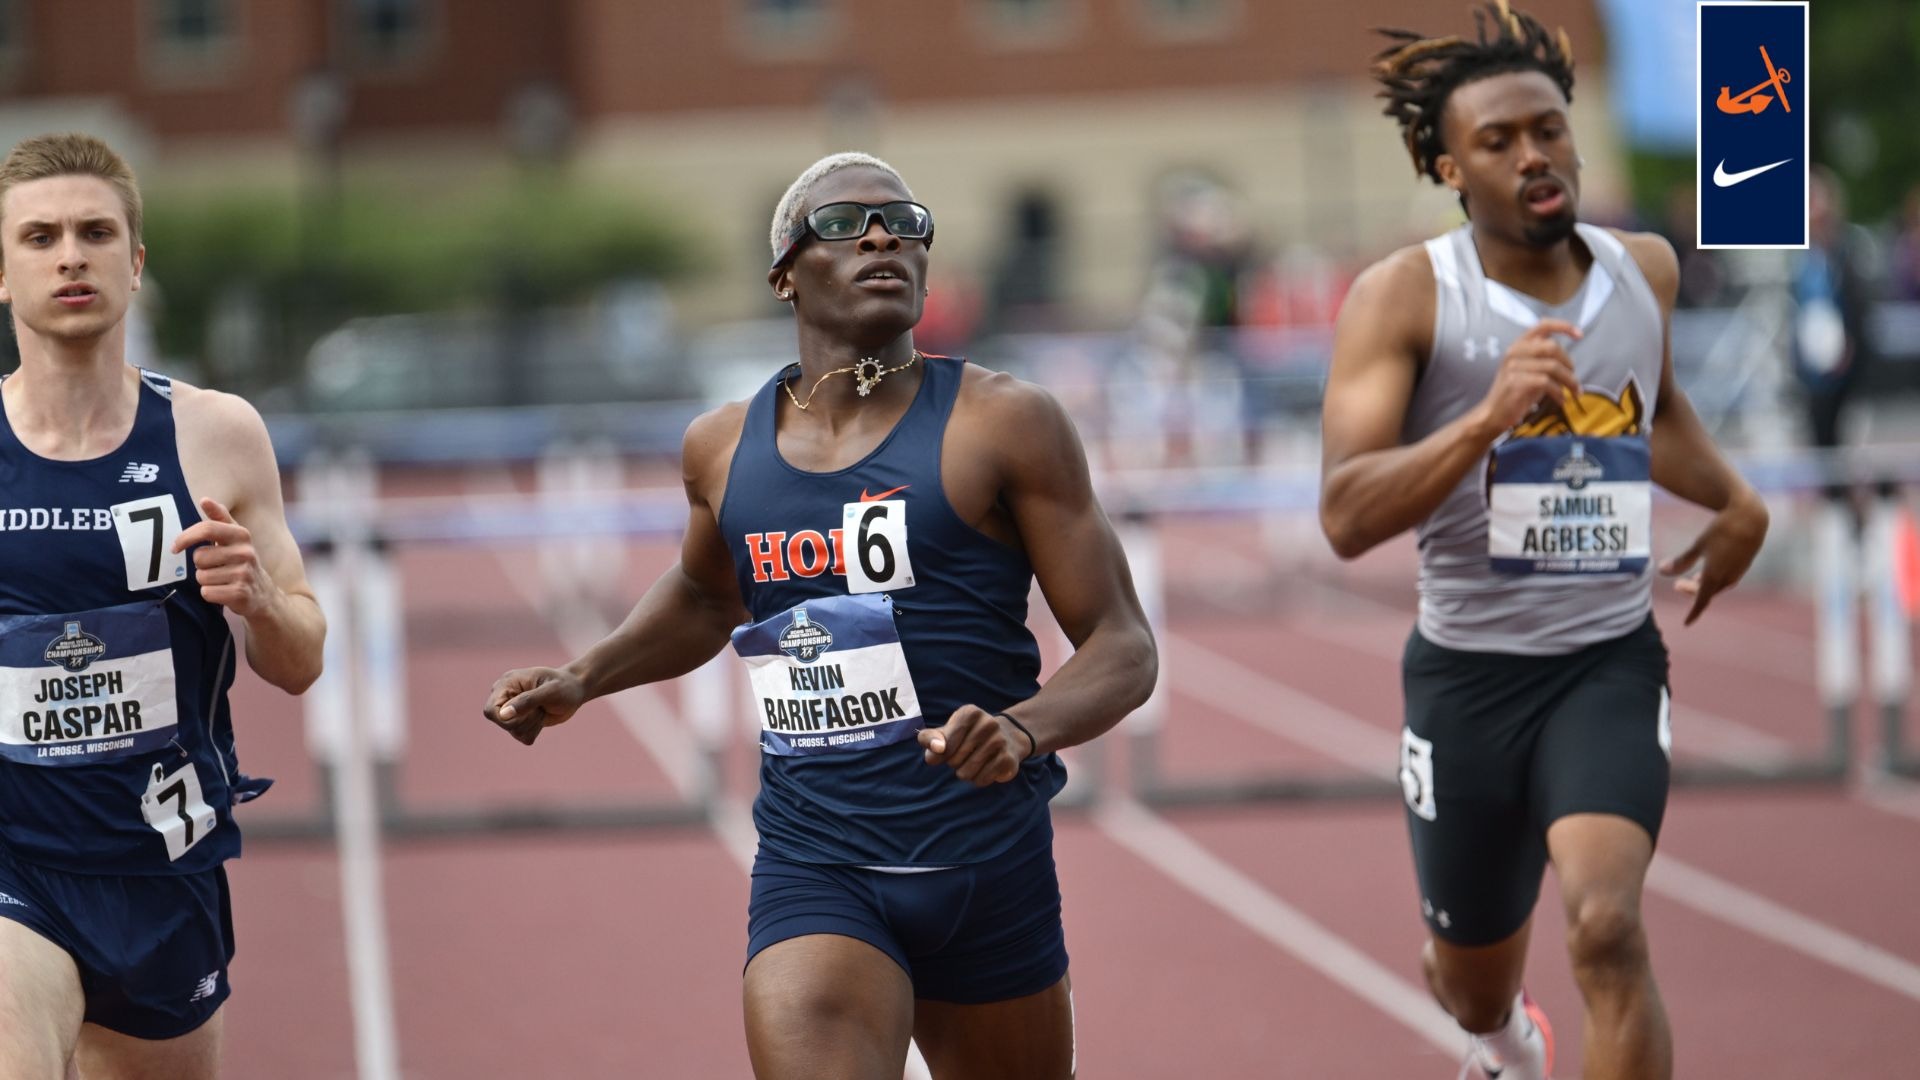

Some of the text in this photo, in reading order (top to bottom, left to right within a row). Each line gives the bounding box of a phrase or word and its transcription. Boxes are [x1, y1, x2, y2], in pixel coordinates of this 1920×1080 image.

[1540, 495, 1616, 516] SAMUEL
[128, 506, 164, 583] 7
[858, 505, 896, 583] 6
[1522, 525, 1627, 552] AGBESSI
[46, 645, 104, 659] CHAMPIONSHIPS
[780, 635, 831, 649] CHAMPIONSHIPS
[34, 670, 123, 703] JOSEPH
[788, 664, 845, 691] KEVIN
[23, 700, 143, 742] CASPAR
[763, 687, 906, 731] BARIFAGOK
[37, 737, 134, 757] LA CROSSE, WISCONSIN
[797, 737, 828, 748] CROSSE,
[828, 730, 875, 746] WISCONSIN
[156, 778, 194, 848] 7
